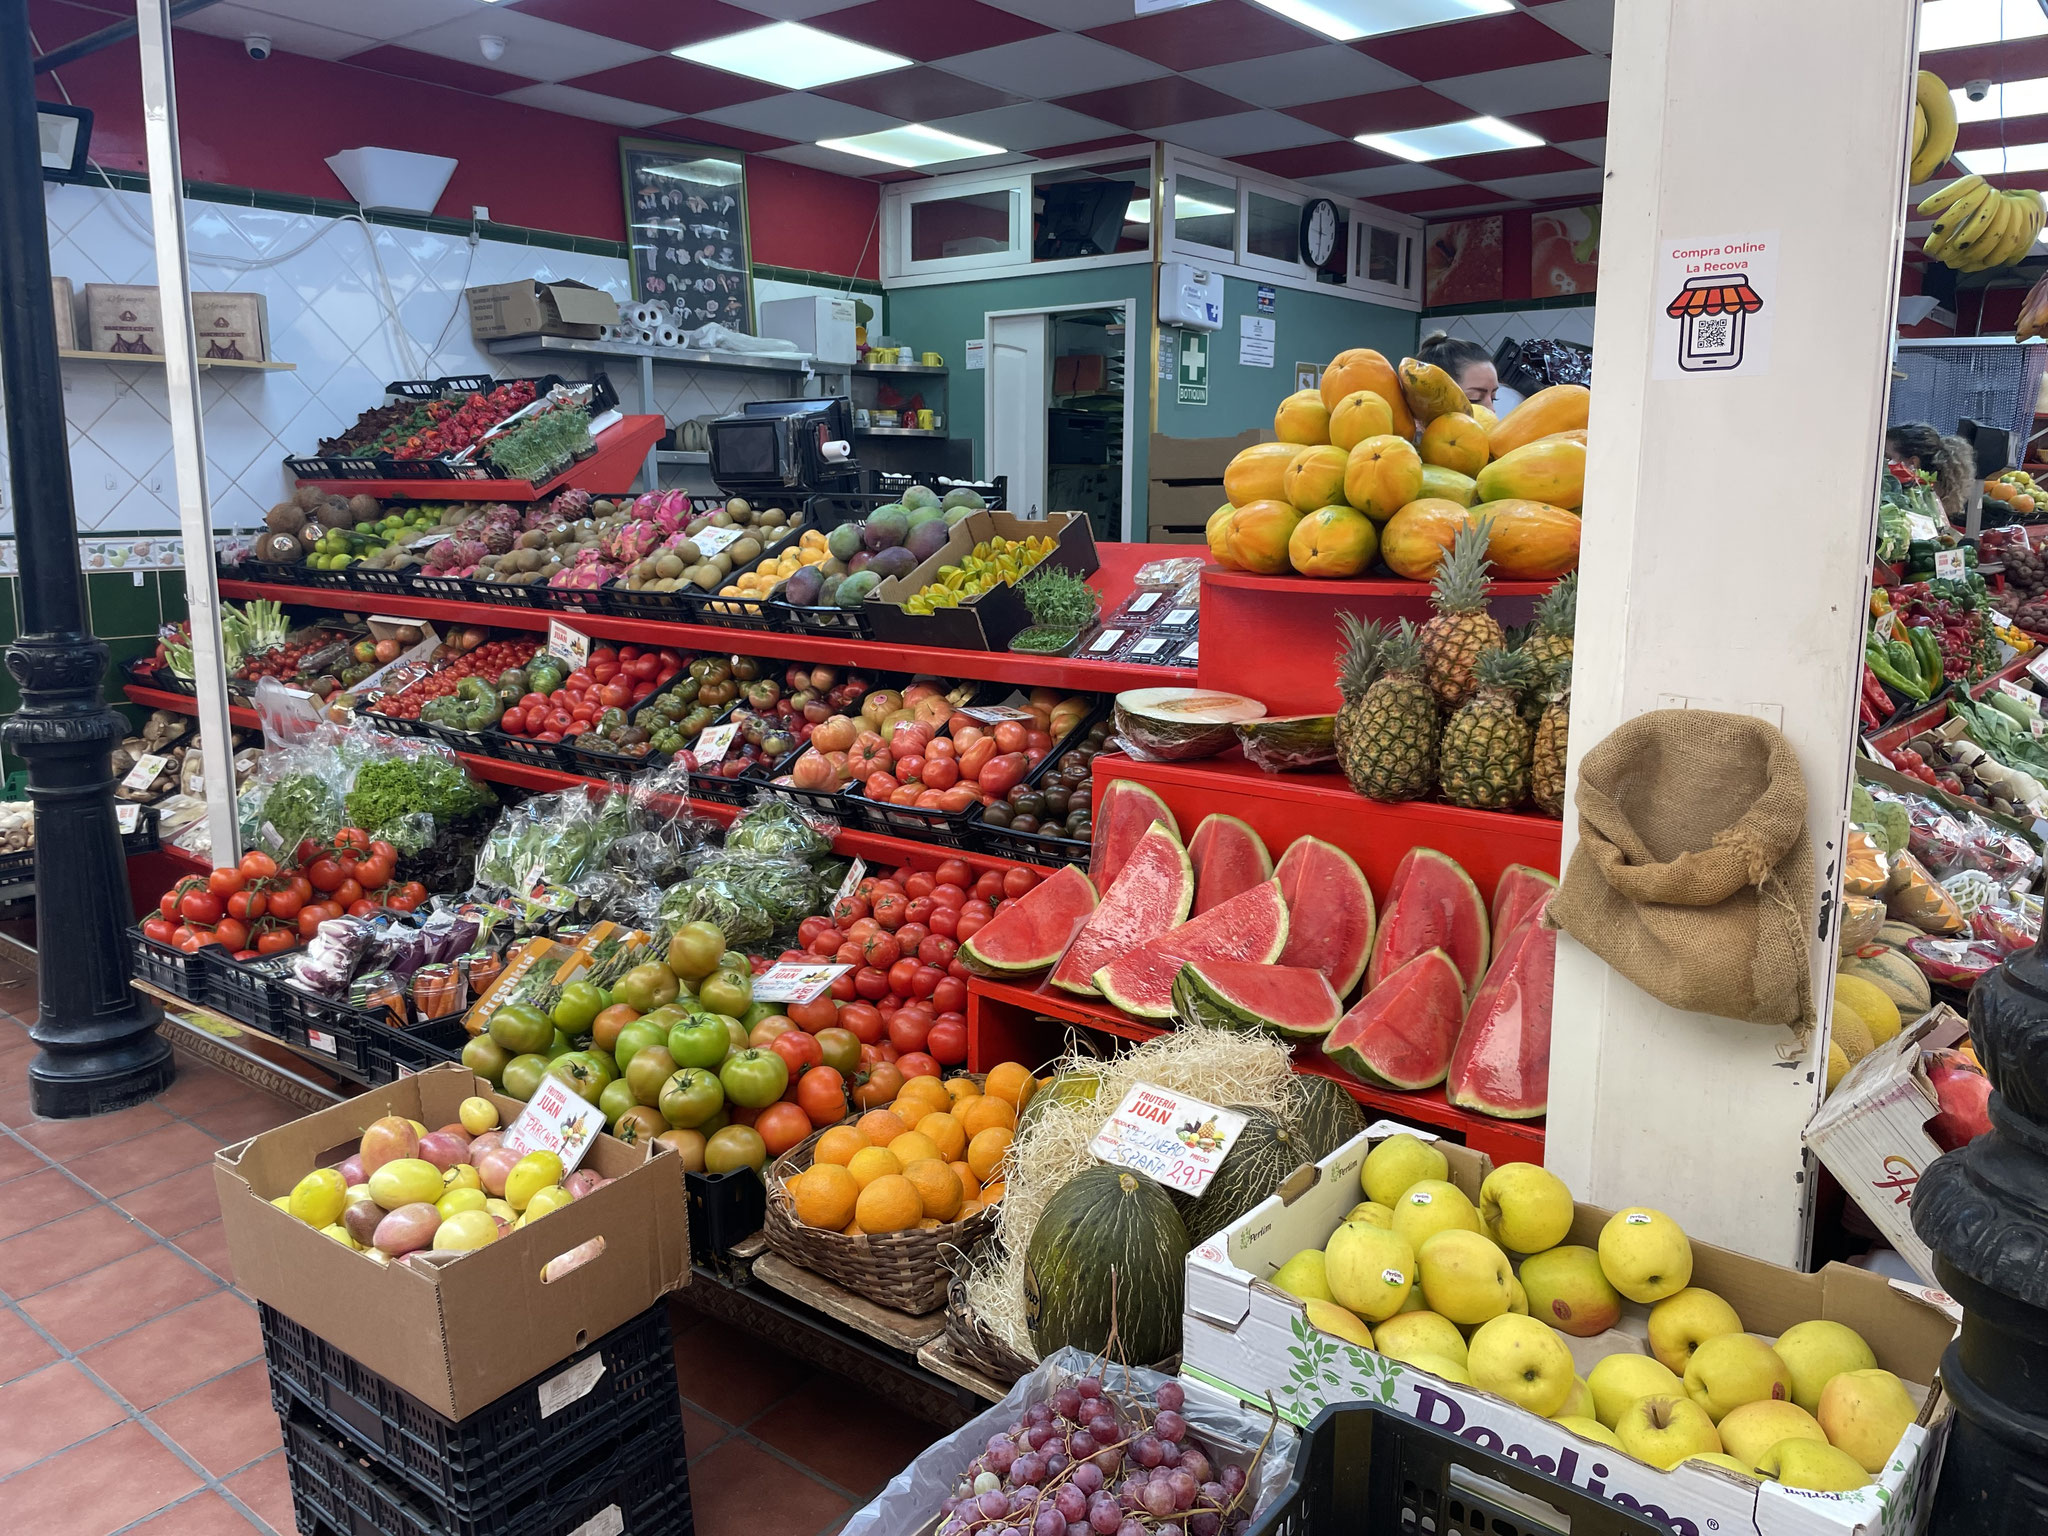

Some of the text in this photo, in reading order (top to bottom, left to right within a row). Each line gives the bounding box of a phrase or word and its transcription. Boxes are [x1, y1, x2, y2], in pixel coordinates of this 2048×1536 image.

[1672, 242, 1766, 259] Compra Online
[1686, 261, 1748, 273] La Recova
[1180, 388, 1206, 401] BOTIQUIN
[769, 972, 799, 980] JUAN
[545, 1085, 568, 1105] FRUTERÍA
[1138, 1091, 1177, 1111] FRUTERÍA
[537, 1095, 563, 1119] JUAN
[1128, 1101, 1173, 1126] JUAN
[525, 1117, 561, 1151] PARCHITA
[511, 1137, 536, 1155] TENE
[1189, 1153, 1210, 1164] PRECIO
[1167, 1160, 1215, 1186] 2,95
[1783, 1487, 1843, 1501] Perlim
